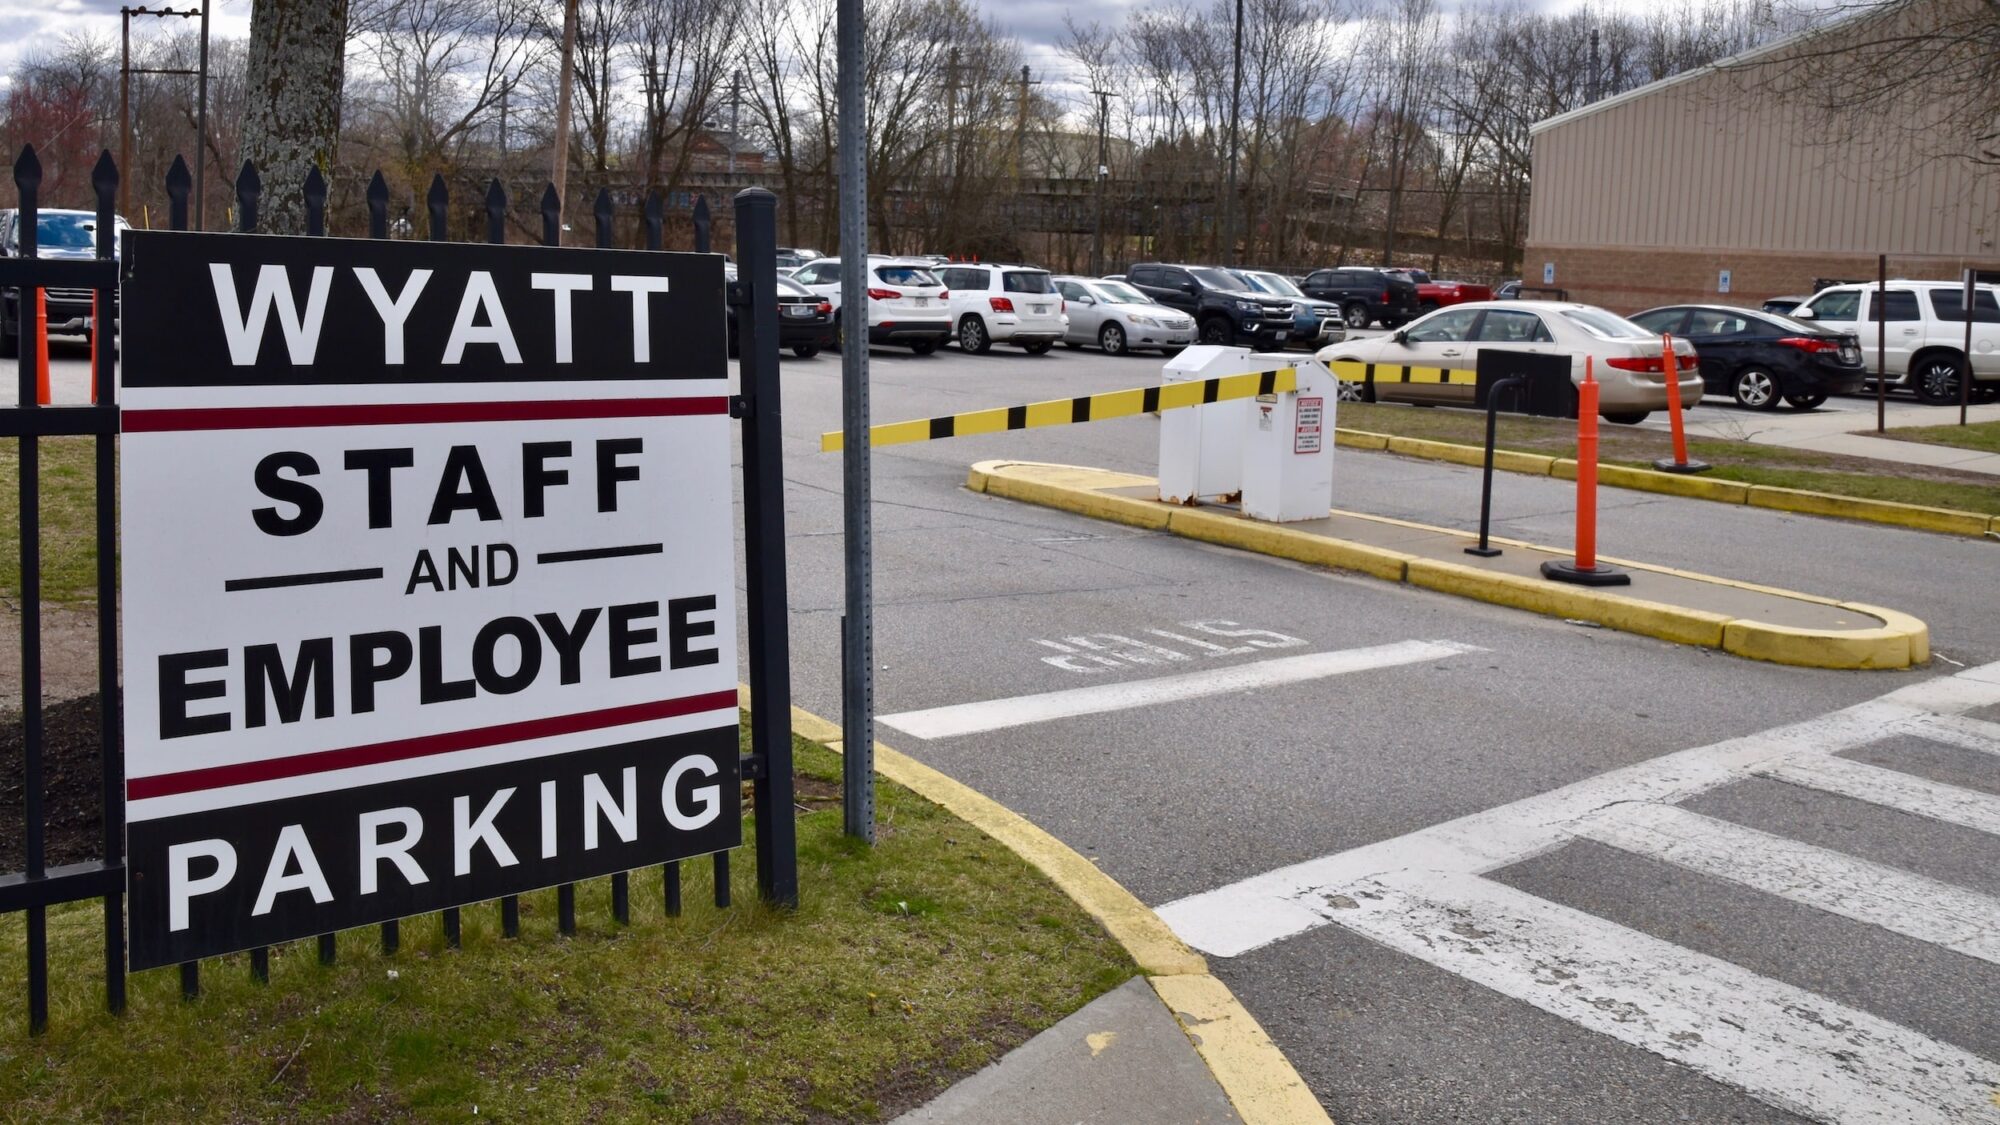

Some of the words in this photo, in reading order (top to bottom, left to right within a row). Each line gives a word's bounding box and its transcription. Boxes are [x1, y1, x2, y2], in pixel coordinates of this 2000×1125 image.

[209, 263, 669, 366] WYATT
[252, 438, 643, 536] STAFF
[405, 544, 518, 594] AND
[159, 595, 719, 740] EMPLOYEE
[169, 755, 720, 931] PARKING
